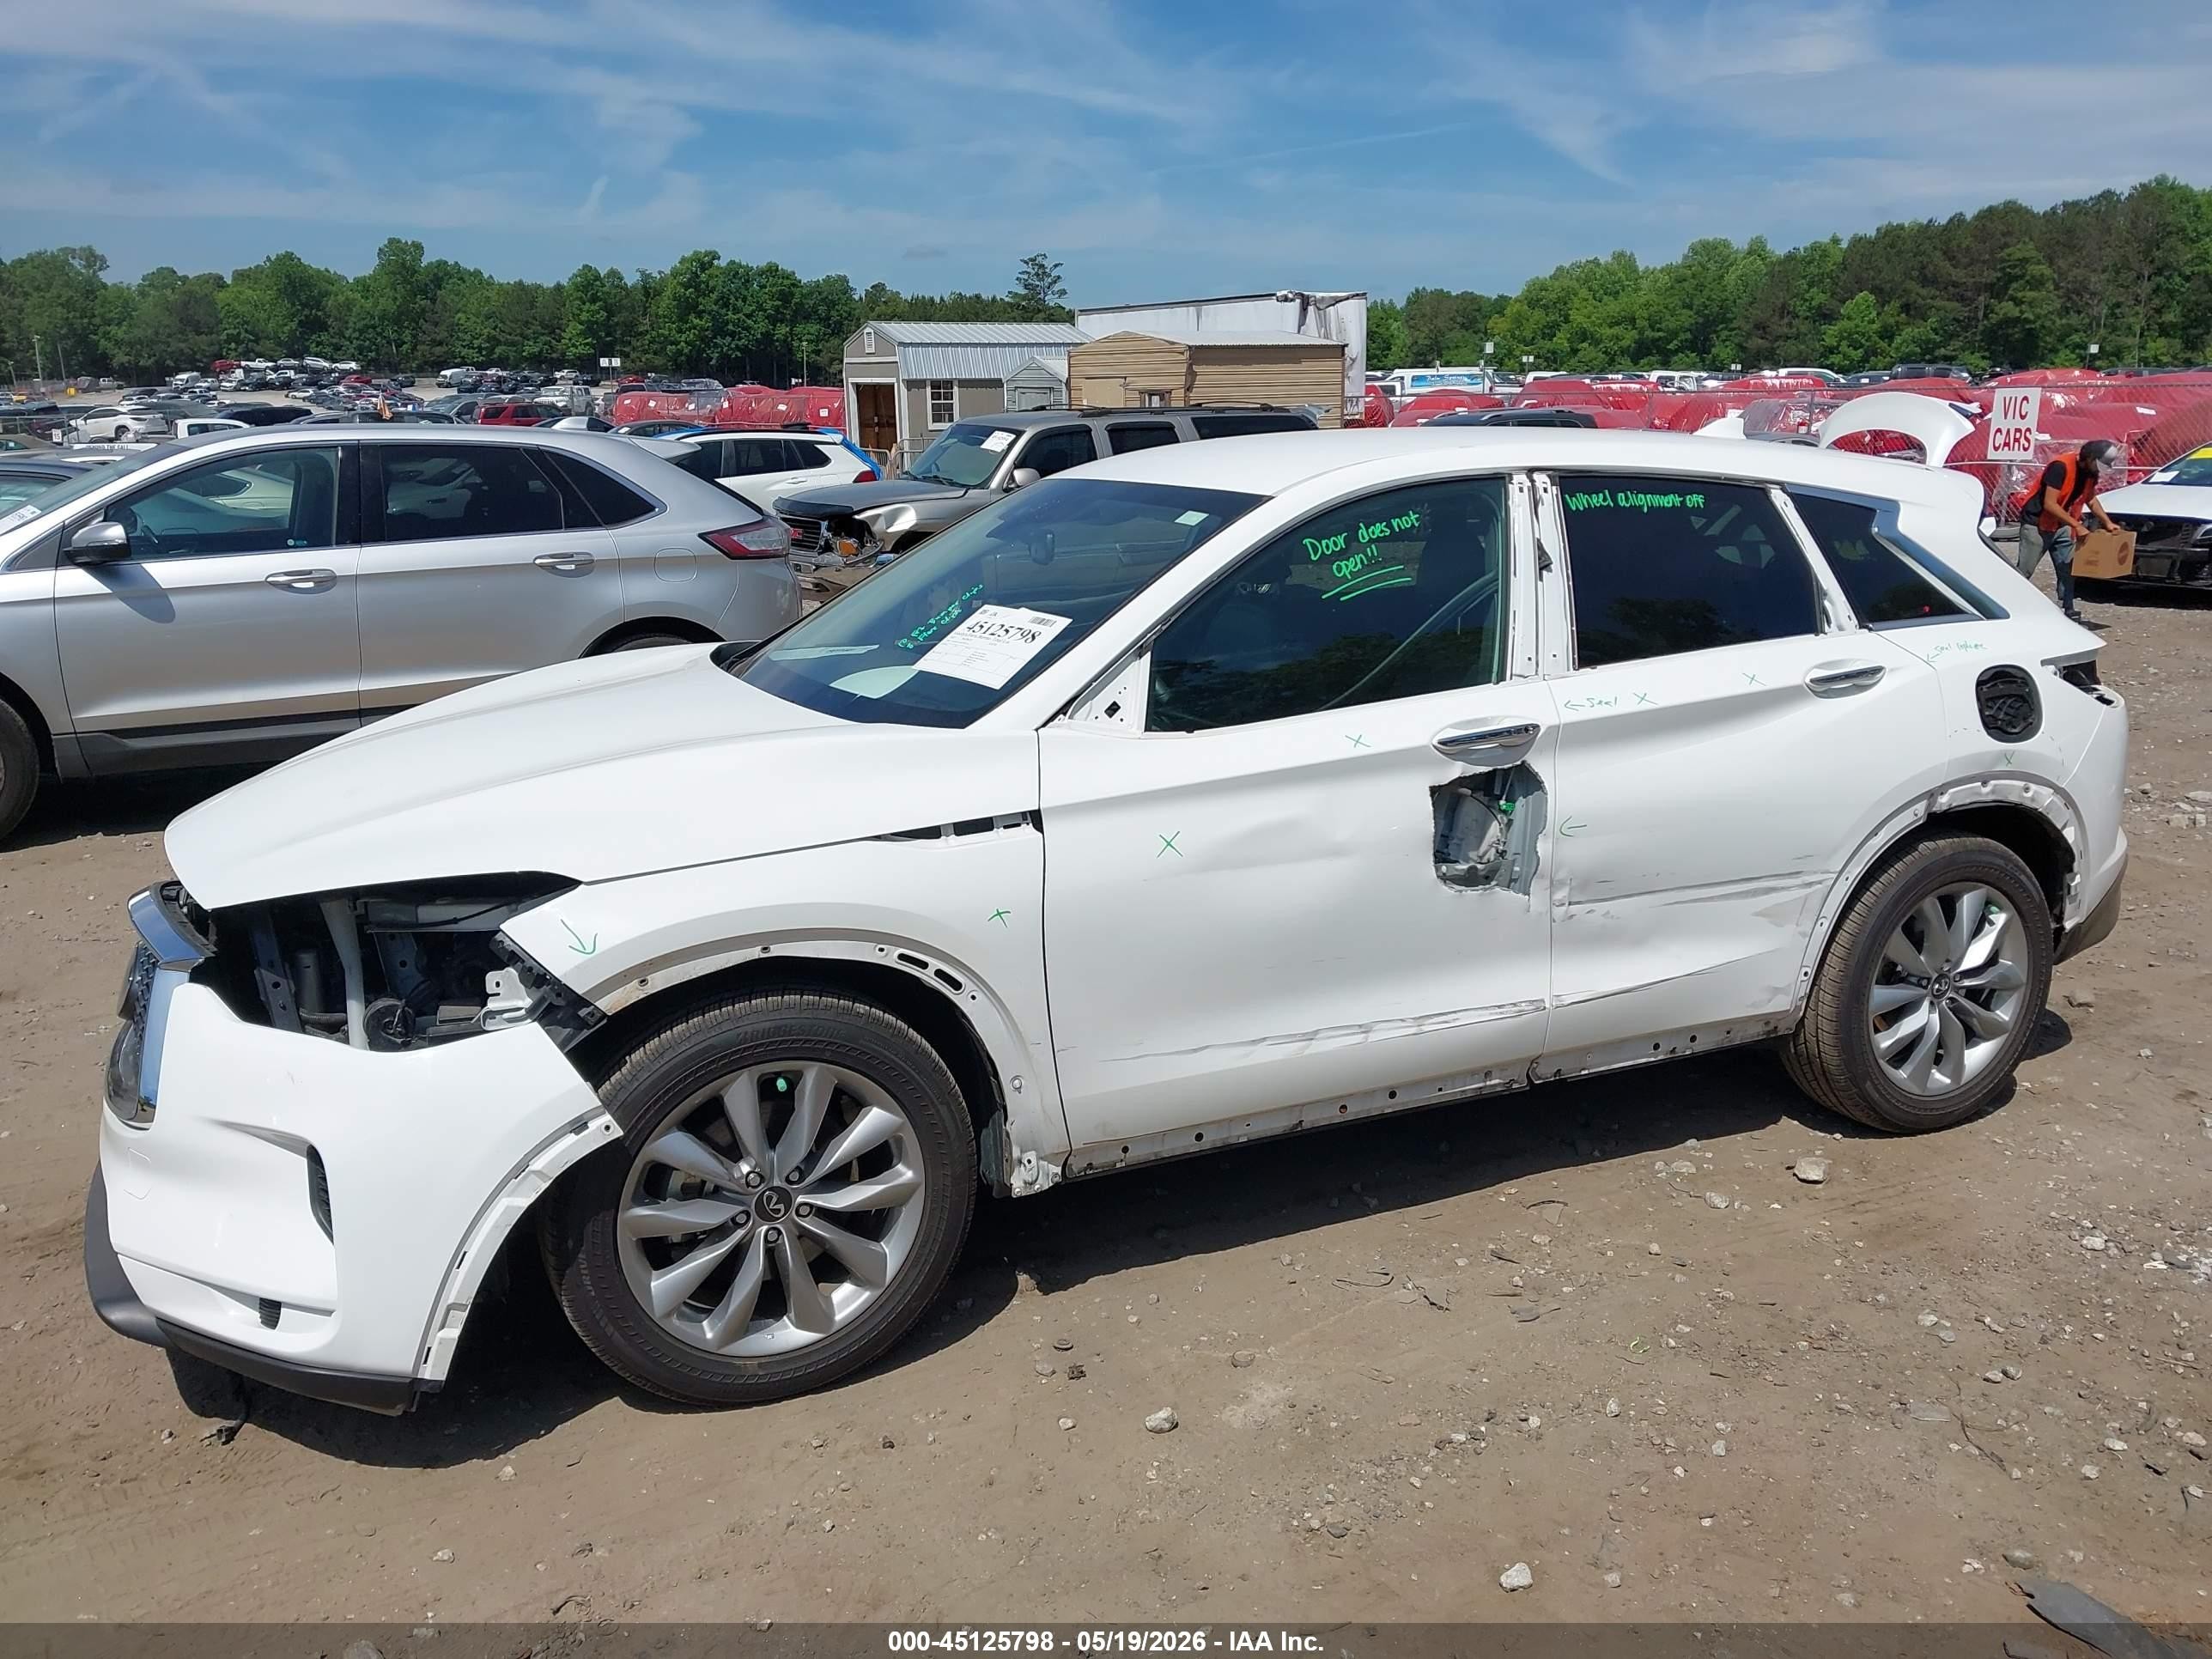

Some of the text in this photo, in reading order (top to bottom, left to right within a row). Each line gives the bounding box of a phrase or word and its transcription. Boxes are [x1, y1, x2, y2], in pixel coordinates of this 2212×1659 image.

[2003, 396, 2029, 420] VIC
[1992, 427, 2032, 452] CARS
[1565, 489, 1613, 511] Wheel
[1618, 490, 1683, 514] alignment
[1303, 510, 1419, 561] Door does not
[1332, 544, 1382, 579] open!!
[967, 621, 1042, 643] 45125798
